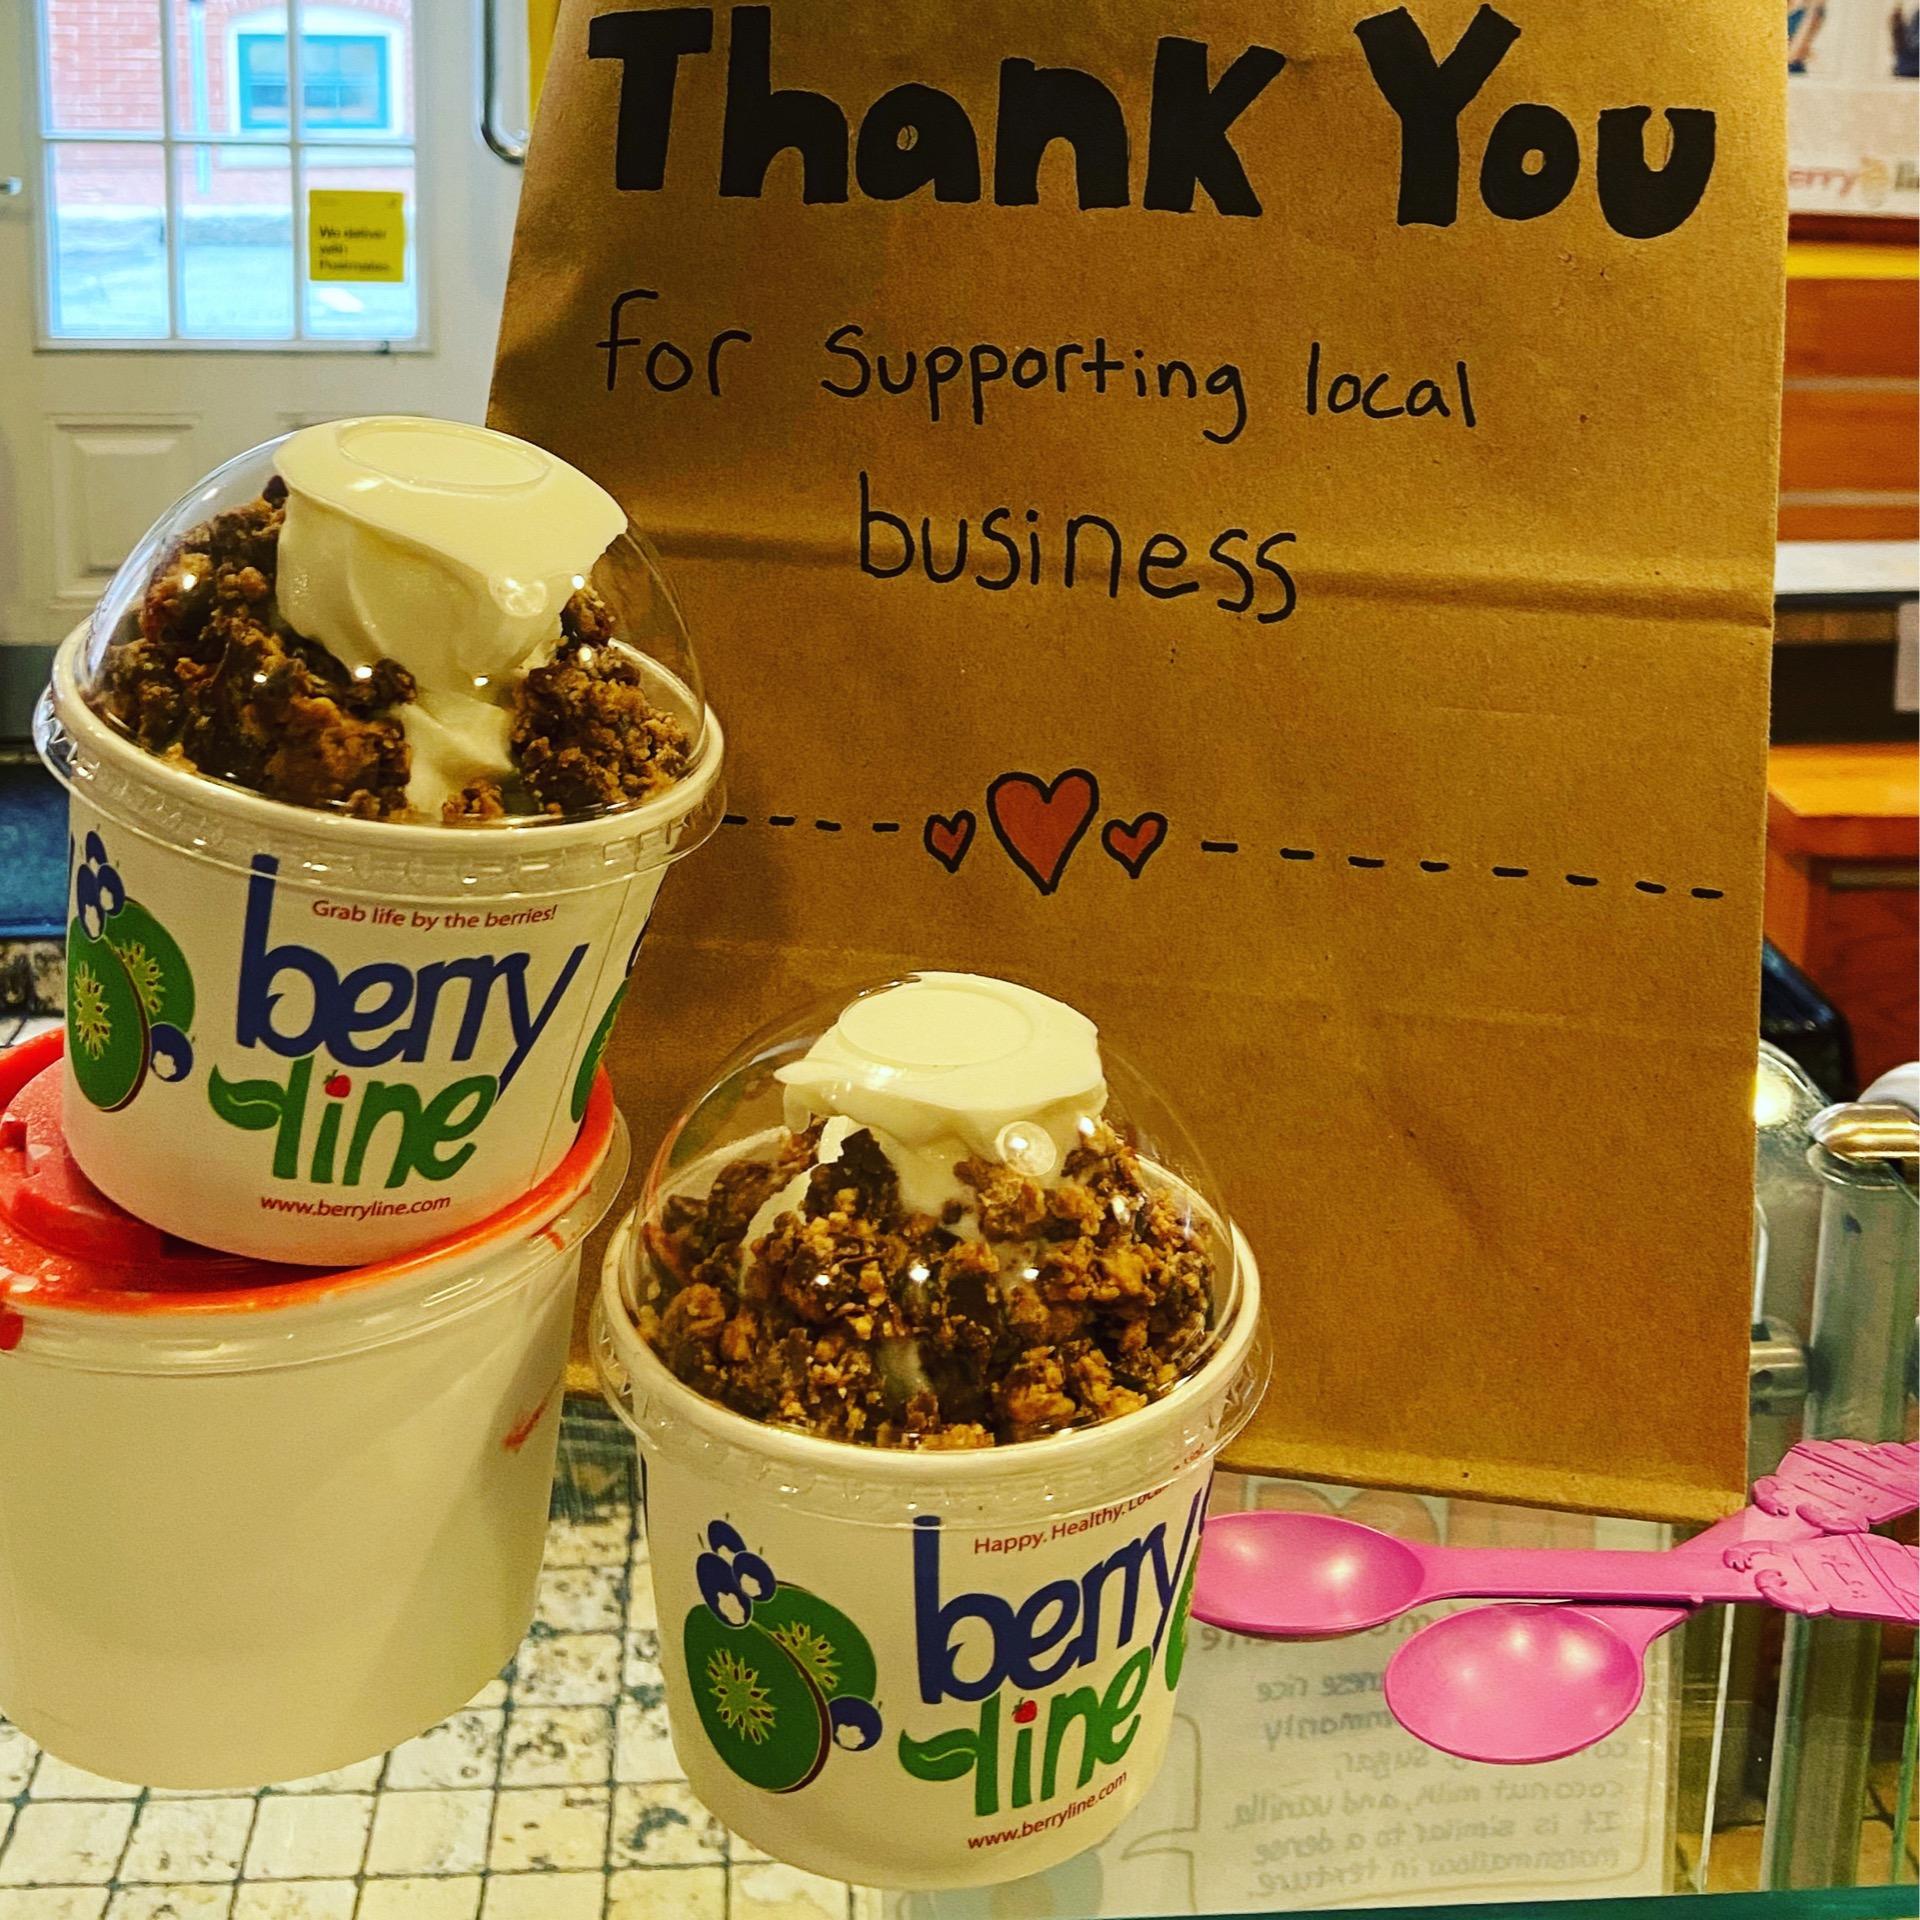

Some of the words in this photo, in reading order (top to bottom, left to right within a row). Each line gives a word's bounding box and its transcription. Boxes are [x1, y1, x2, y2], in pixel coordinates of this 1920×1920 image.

[1354, 3, 1717, 240] You
[1788, 168, 1861, 198] erry
[597, 289, 752, 396] for
[1306, 342, 1477, 428] local
[859, 470, 1298, 624] business
[236, 853, 590, 1106] berry
[312, 900, 367, 923] Grab
[372, 905, 406, 926] life
[411, 910, 439, 932] by
[444, 911, 480, 929] the
[484, 904, 558, 928] berries!
[272, 1055, 500, 1189] line
[260, 1195, 451, 1221] www.berryline.com
[912, 1487, 1203, 1705] berry
[974, 1531, 1048, 1555] Happy.
[1051, 1503, 1126, 1540] Healthy.
[974, 1646, 1154, 1817] line
[967, 1770, 1128, 1850] www.berryline.com
